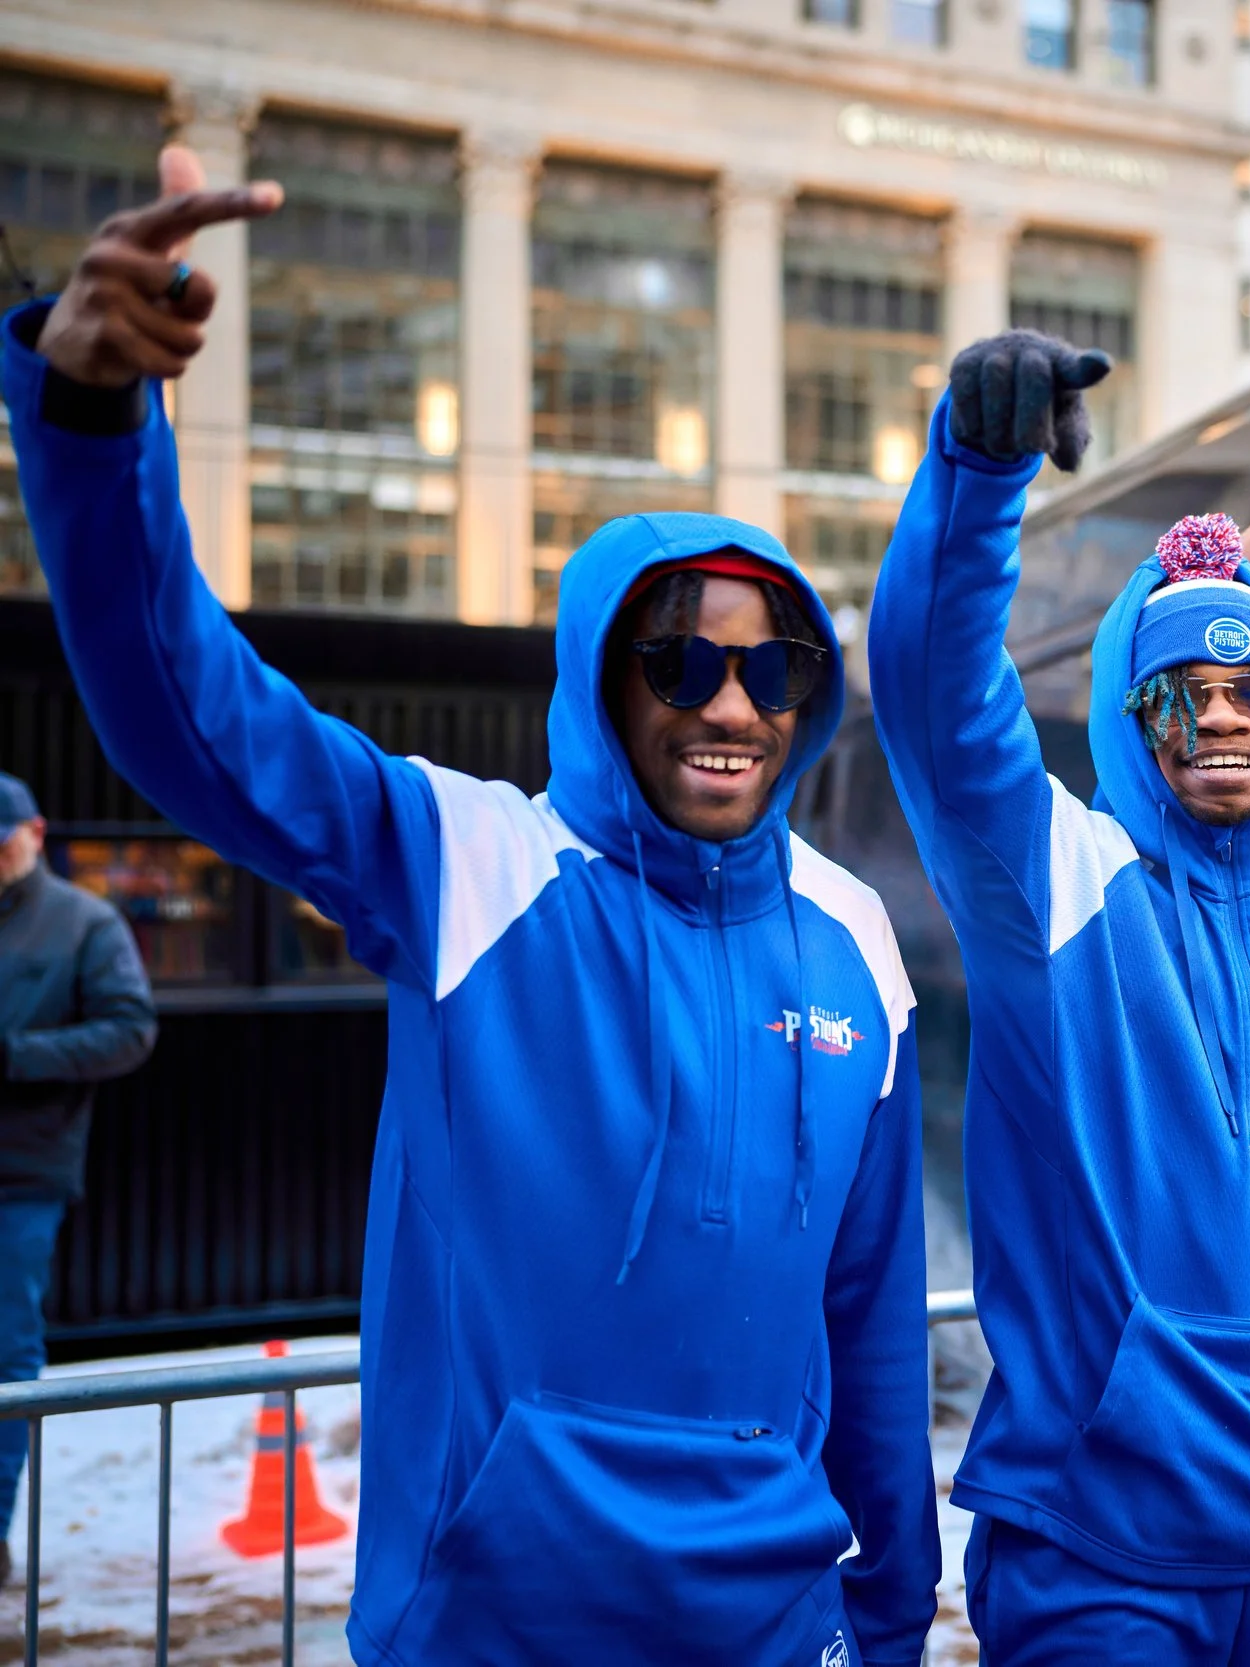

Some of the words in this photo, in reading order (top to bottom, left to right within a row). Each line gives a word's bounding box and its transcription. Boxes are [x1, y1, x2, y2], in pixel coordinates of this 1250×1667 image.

[1214, 629, 1246, 640] DETROIT
[1214, 637, 1245, 648] PISTONS
[810, 1005, 840, 1021] ETROIT
[782, 1009, 853, 1051] PSTONS
